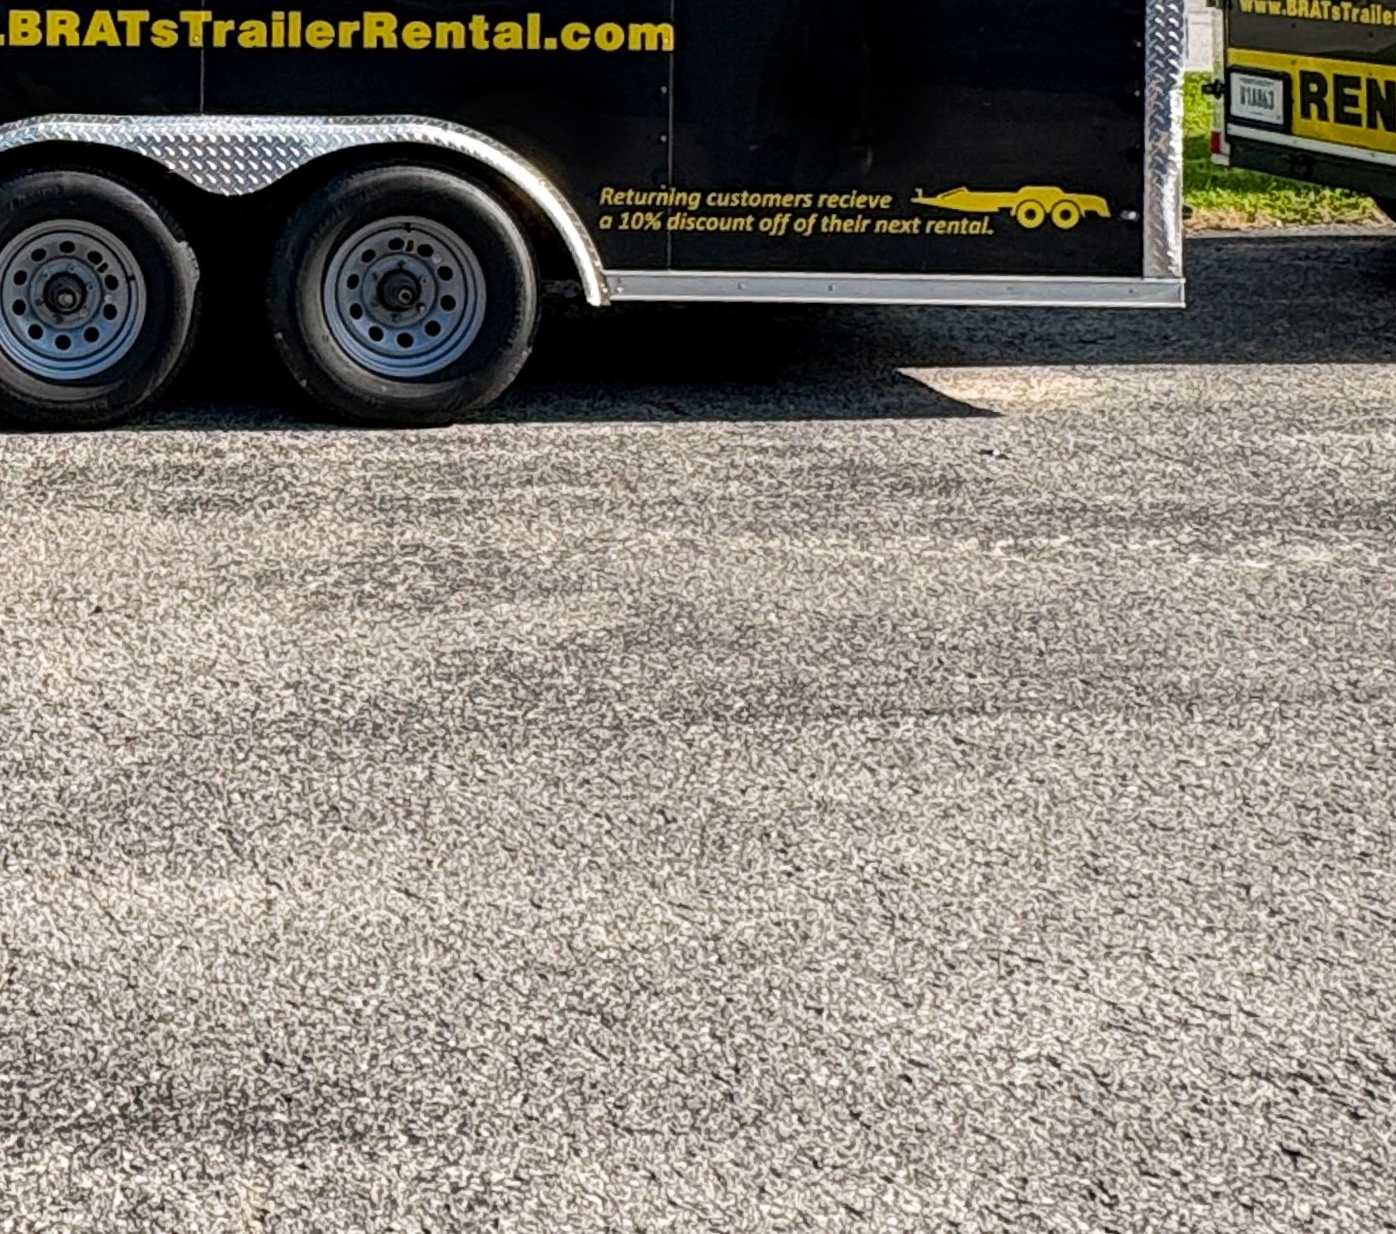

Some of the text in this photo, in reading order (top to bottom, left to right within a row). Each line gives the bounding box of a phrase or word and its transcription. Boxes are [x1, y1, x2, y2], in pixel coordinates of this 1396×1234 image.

[599, 186, 894, 211] Returning customers recieve
[599, 211, 995, 236] a 10% discount off of their next rental.
